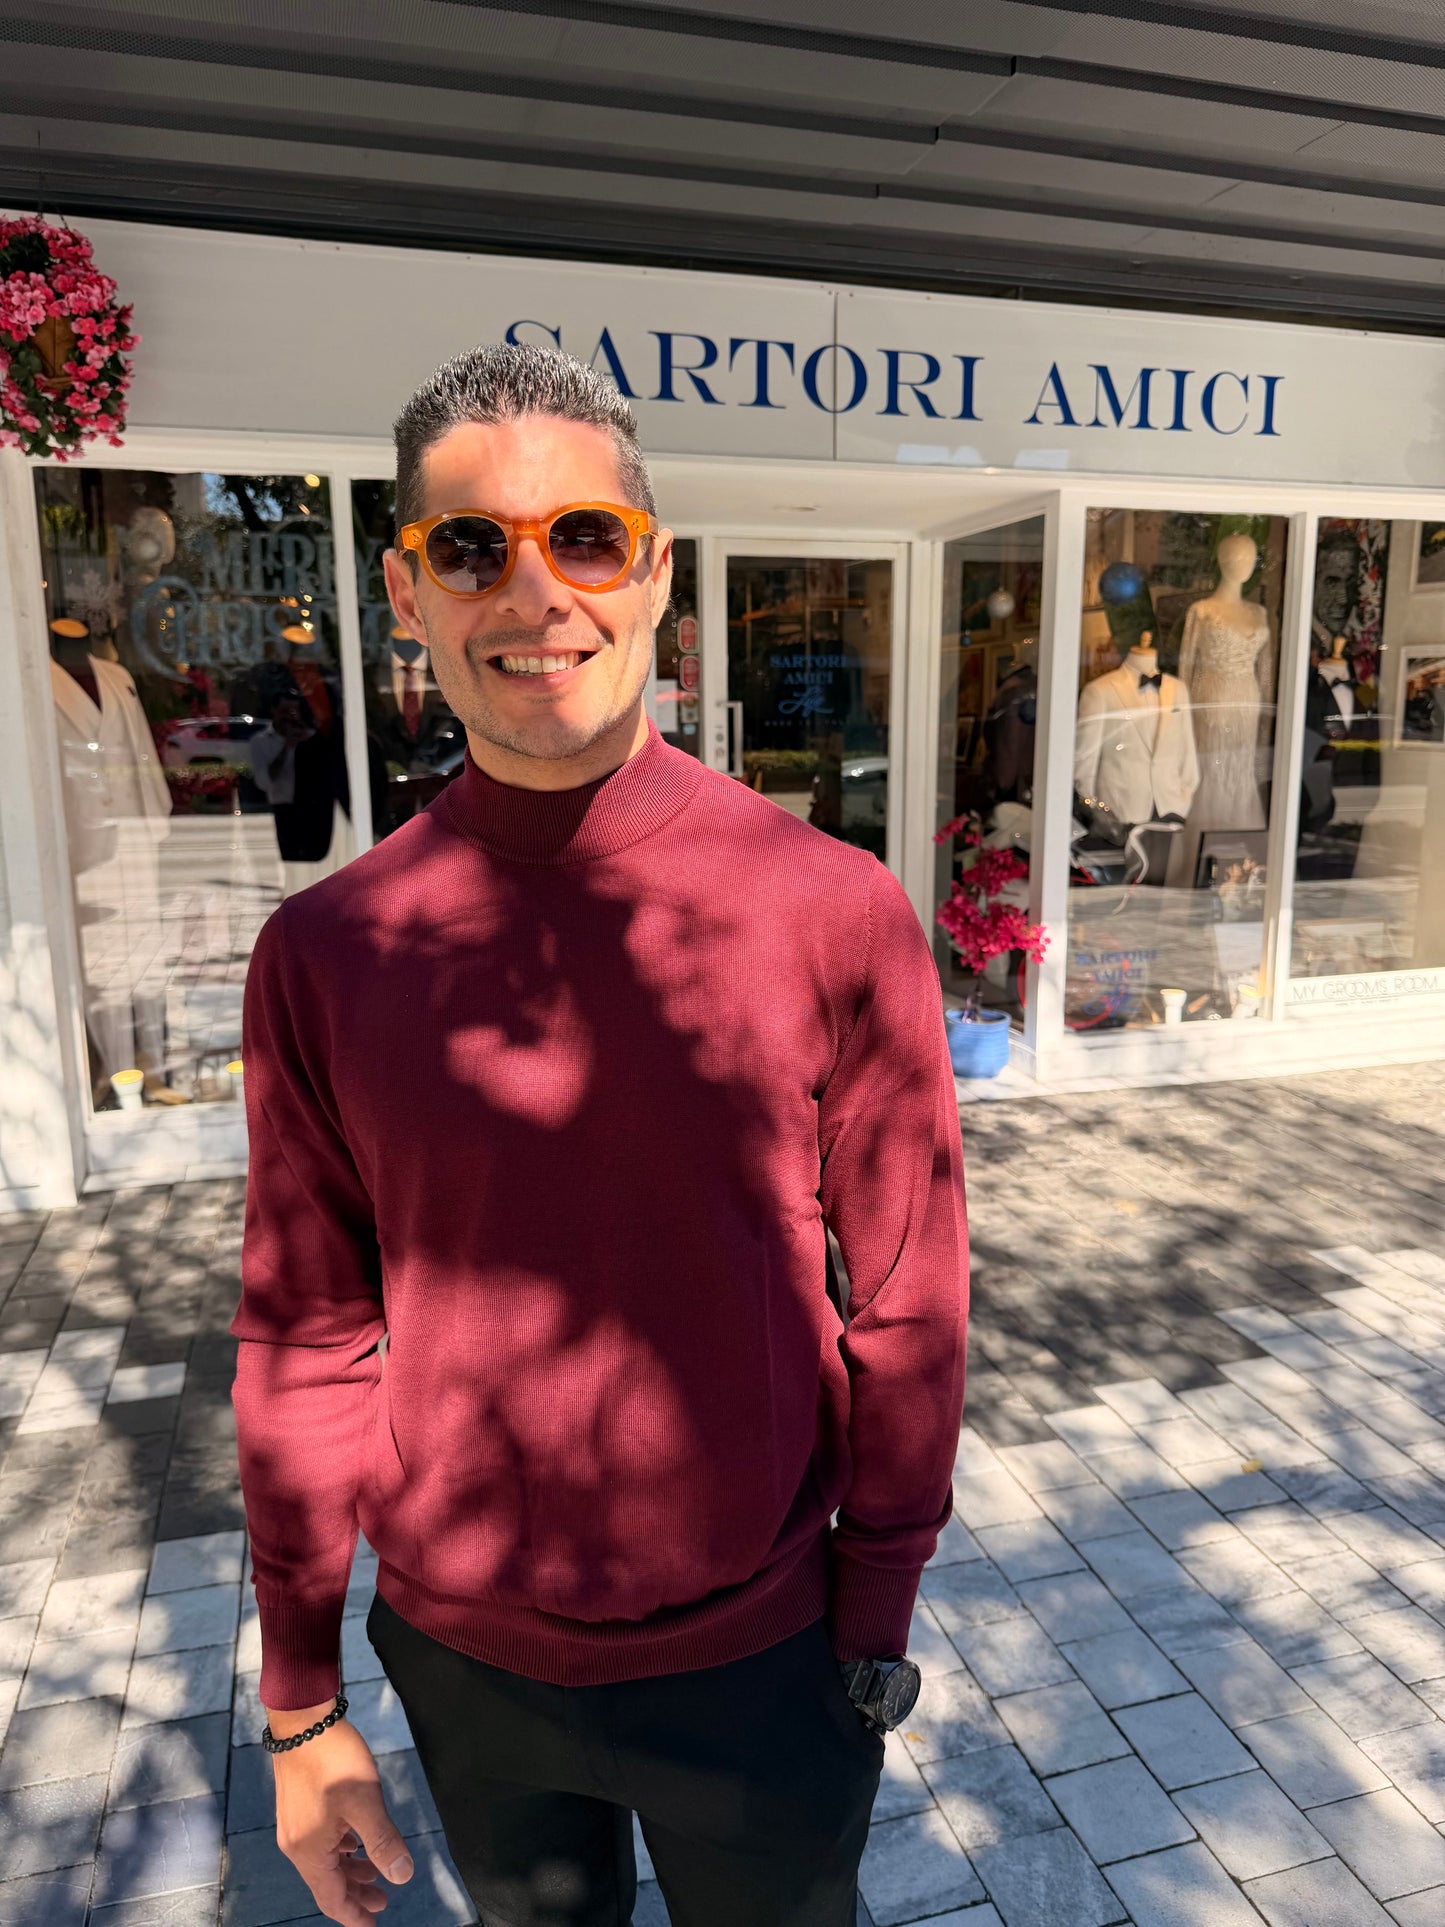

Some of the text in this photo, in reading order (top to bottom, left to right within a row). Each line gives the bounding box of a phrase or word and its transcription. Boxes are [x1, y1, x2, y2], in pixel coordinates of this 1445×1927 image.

[1023, 360, 1286, 437] AMICI
[1292, 984, 1317, 1001] MY
[1393, 974, 1439, 994] ROOM
